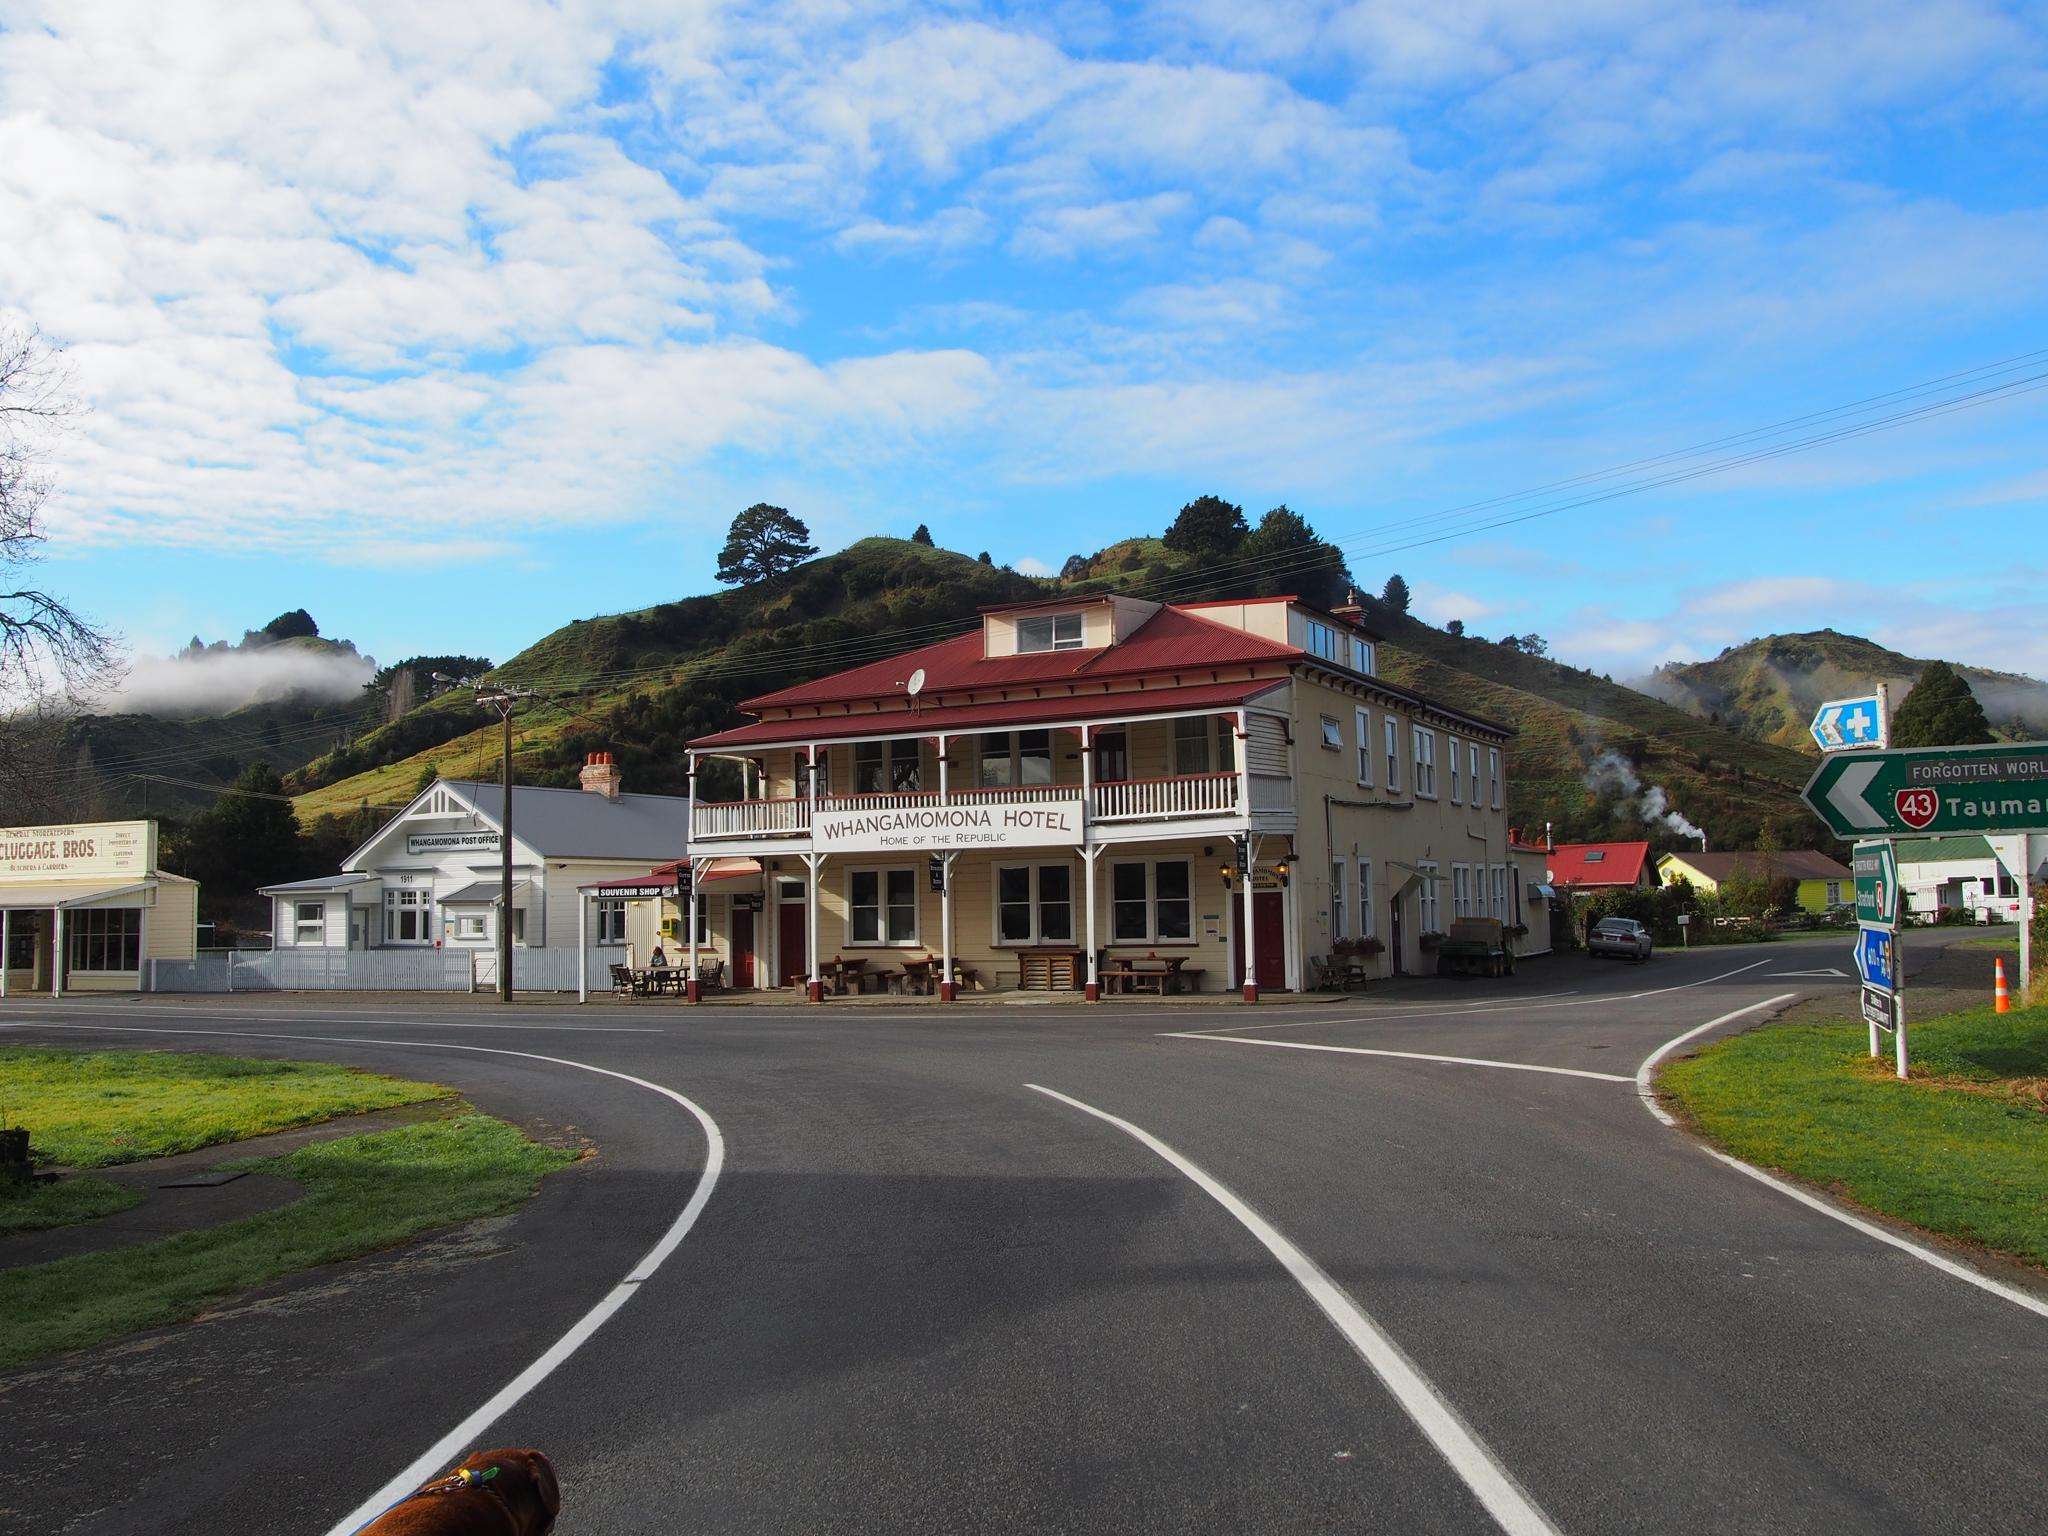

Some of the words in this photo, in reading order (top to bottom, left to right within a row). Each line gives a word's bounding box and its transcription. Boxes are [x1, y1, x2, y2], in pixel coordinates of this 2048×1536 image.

[1912, 763, 1999, 779] FORGOTTEN
[1901, 794, 1932, 816] 43
[1945, 797, 2048, 817] Tauma
[823, 810, 992, 840] WHANGAMOMONA
[1004, 810, 1072, 832] HOTEL
[410, 837, 460, 847] WHANGAMOMONA
[461, 836, 477, 845] POST
[478, 835, 499, 844] OFFICE
[880, 835, 909, 846] HOME
[913, 834, 926, 844] OF
[932, 834, 951, 844] THE
[956, 832, 1007, 843] REPUBLIC
[63, 839, 98, 858] BROS.
[400, 875, 413, 883] 1911
[600, 888, 638, 897] SOUVENIR
[639, 887, 660, 896] SHOP
